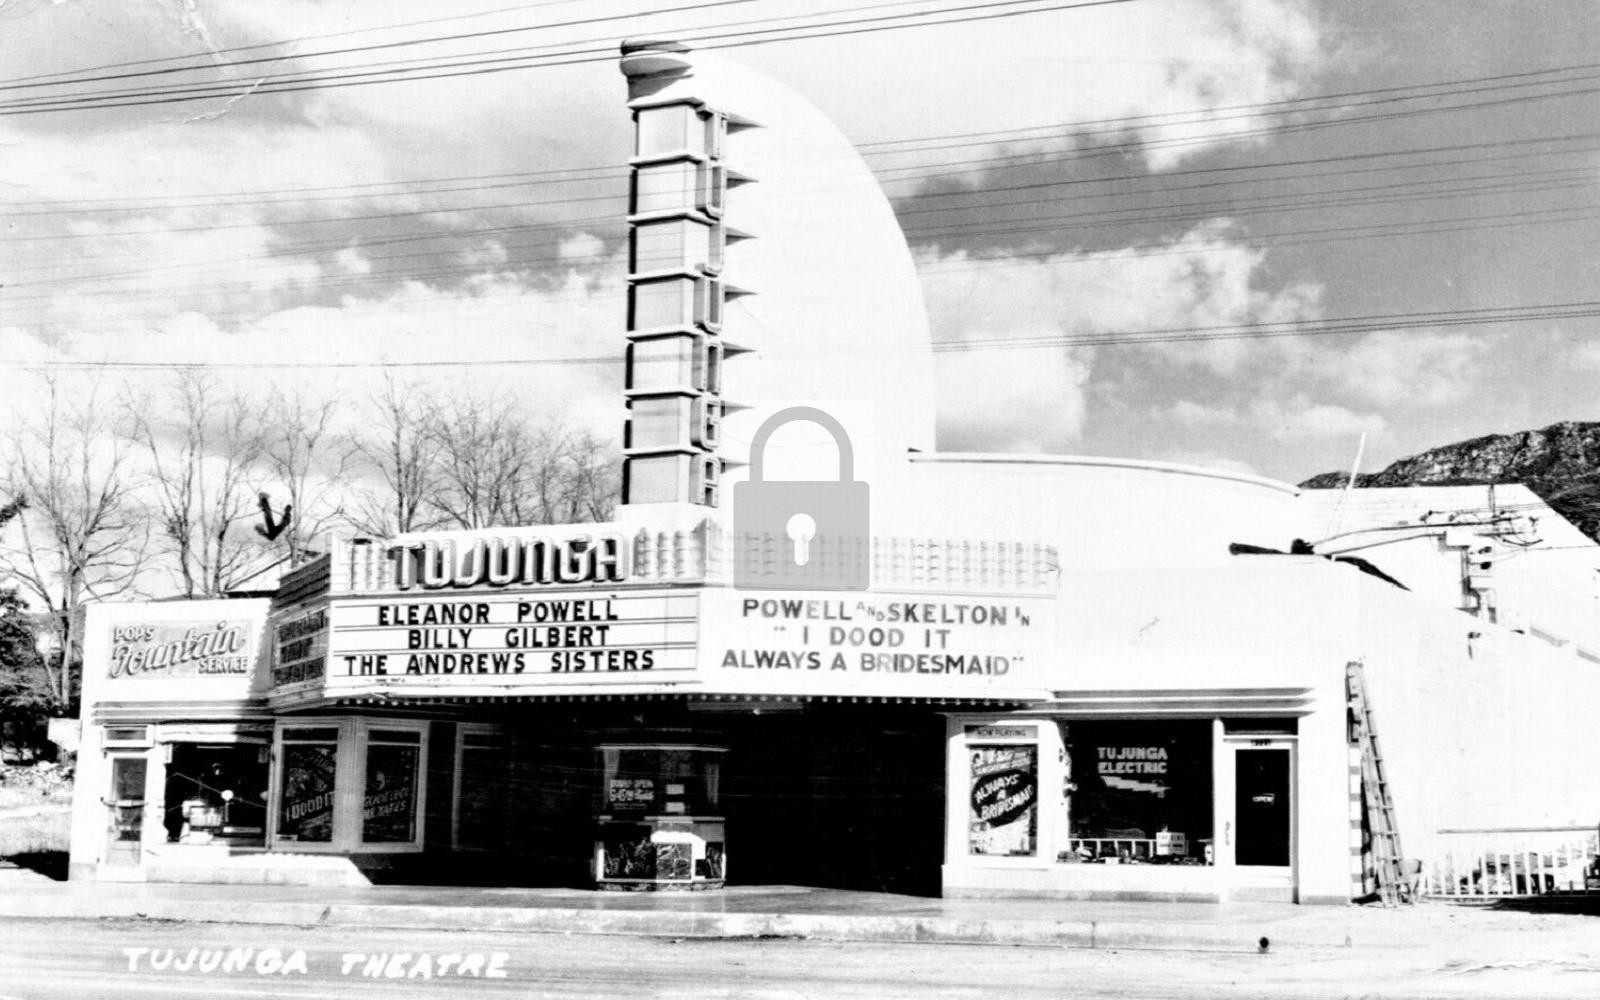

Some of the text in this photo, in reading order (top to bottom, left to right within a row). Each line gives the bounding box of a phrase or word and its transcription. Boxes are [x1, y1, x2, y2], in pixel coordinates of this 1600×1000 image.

[390, 533, 626, 591] TUJUNGA
[377, 599, 619, 626] ELEANOR POWELL
[742, 599, 853, 620] POWELL
[856, 601, 885, 622] AND
[887, 602, 1008, 626] SKELTON
[110, 620, 241, 678] Fountain
[408, 625, 610, 650] BILLY GILBERT
[829, 626, 904, 648] DOOD
[924, 628, 951, 649] IT
[198, 656, 249, 674] SERVICE
[344, 655, 388, 676] THE
[405, 652, 526, 676] ANDREWS
[550, 649, 655, 673] SISTERS
[721, 649, 821, 670] ALWAYS
[830, 651, 847, 672] A
[1096, 747, 1168, 760] TUJUNGA
[1097, 761, 1168, 774] ELECTRIC
[974, 774, 1020, 804] ALWAYS
